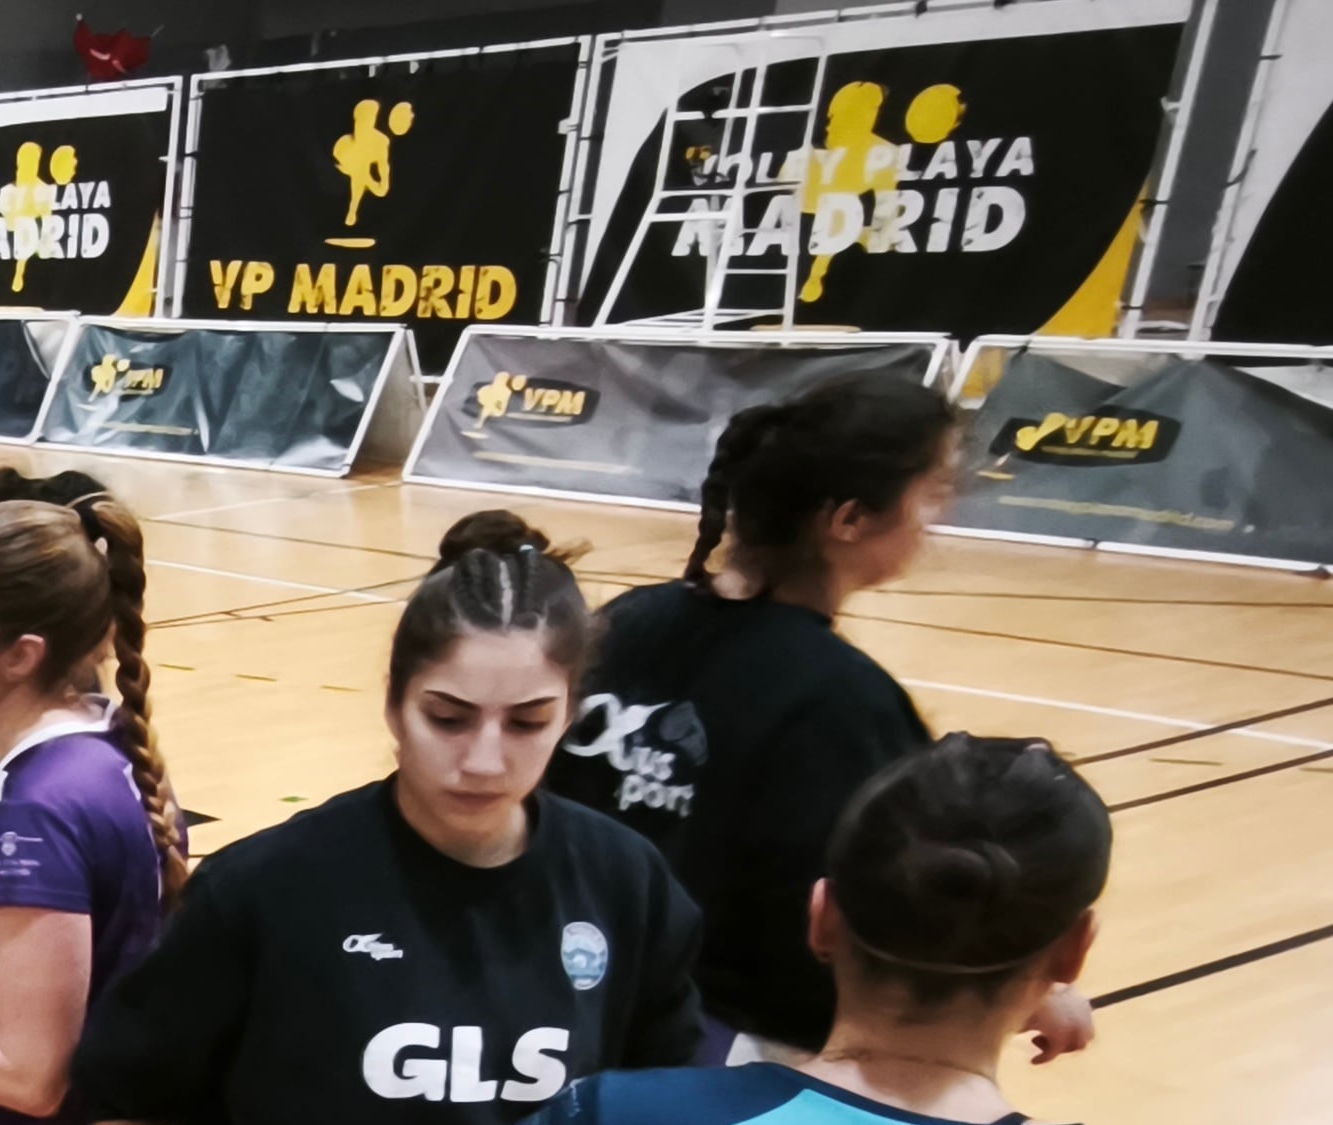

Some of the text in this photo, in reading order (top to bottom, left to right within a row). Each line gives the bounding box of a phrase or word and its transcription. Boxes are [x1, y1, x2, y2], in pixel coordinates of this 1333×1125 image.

[863, 136, 1035, 179] PLAYA
[671, 186, 1027, 257] MADRID
[208, 260, 518, 320] VP MADRID
[523, 388, 586, 416] VPM
[1064, 415, 1160, 450] VPM
[362, 1022, 570, 1103] GLS
